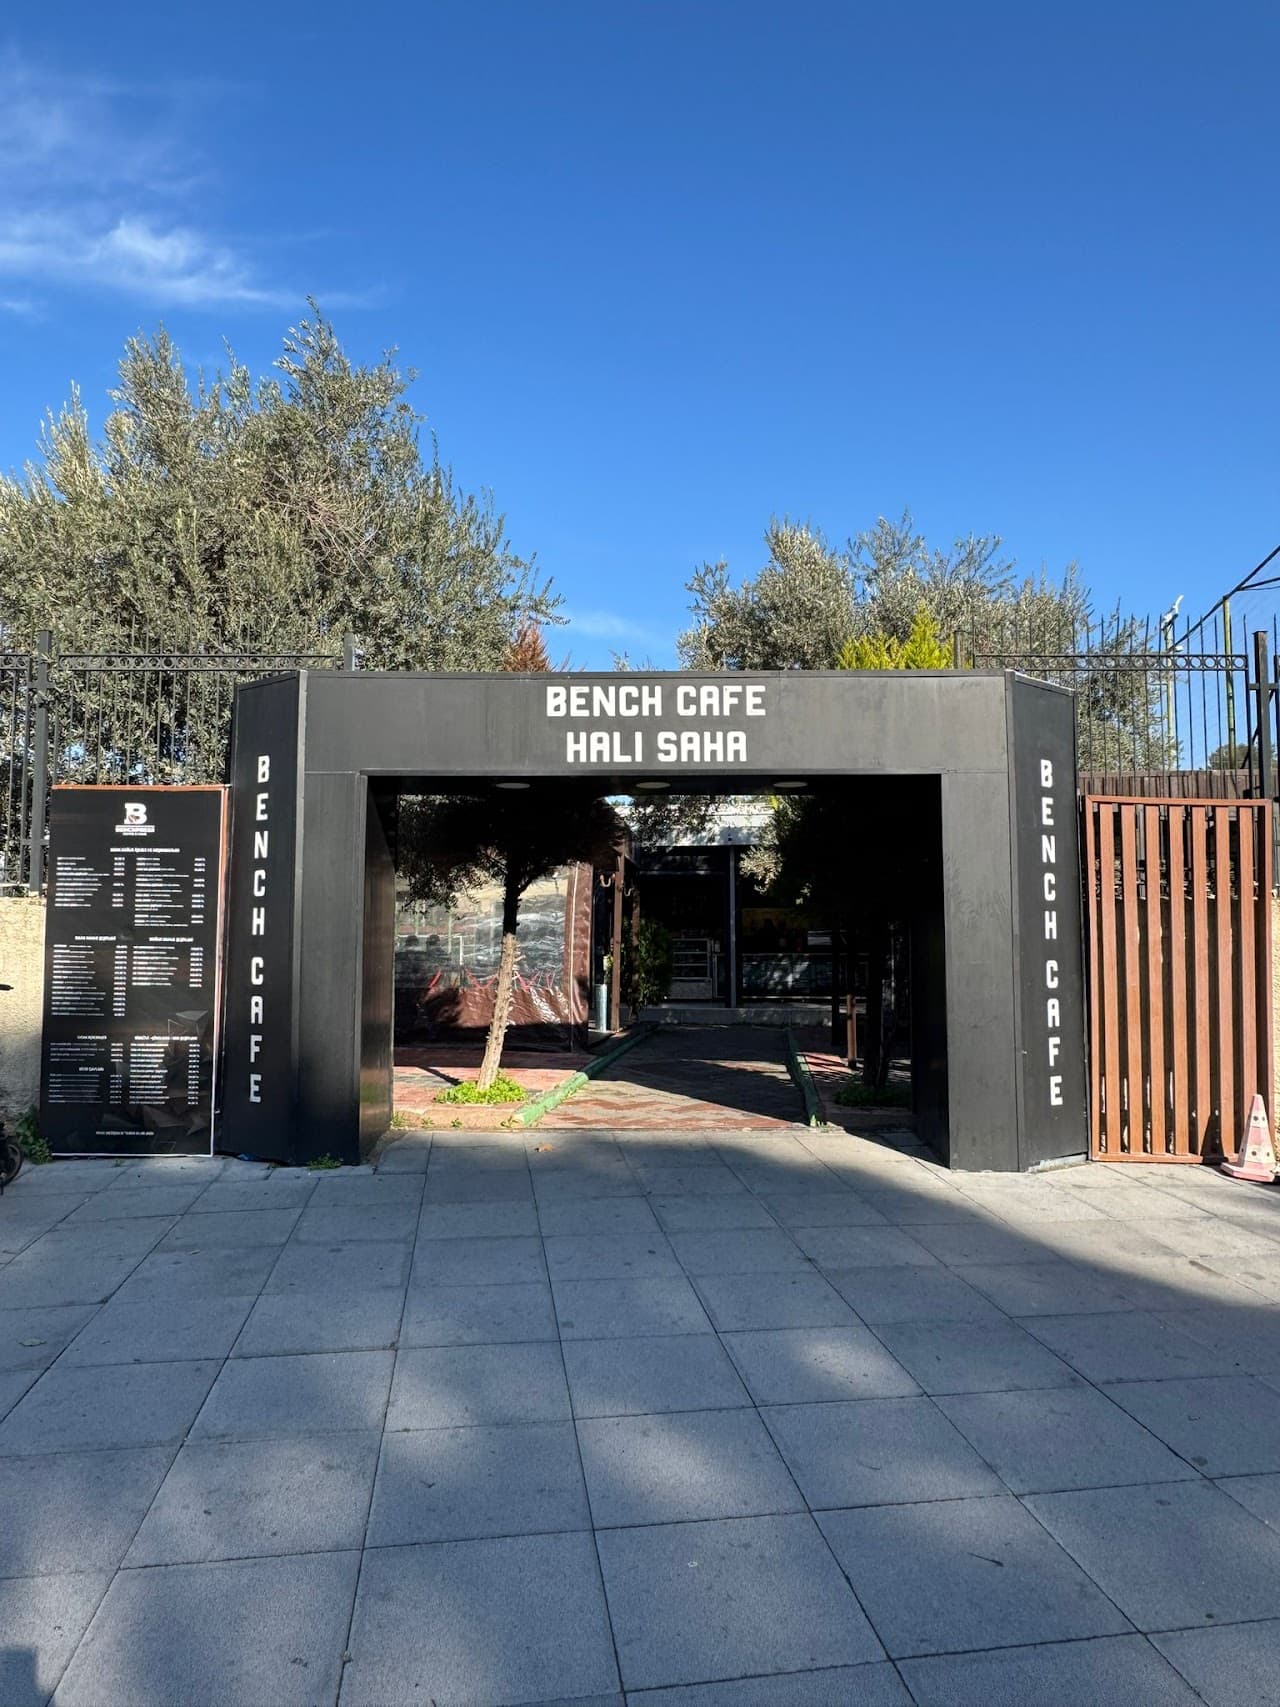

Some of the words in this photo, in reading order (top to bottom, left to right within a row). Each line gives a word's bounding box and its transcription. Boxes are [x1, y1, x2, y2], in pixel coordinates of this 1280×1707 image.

[546, 685, 662, 717] BENCH
[676, 685, 766, 717] CAFE
[566, 731, 643, 763] HALI
[657, 731, 747, 762] SAHA
[124, 802, 148, 825] B
[252, 755, 270, 936] BENCH
[1040, 759, 1057, 940] BENCH
[250, 956, 264, 1104] CAFE
[1046, 959, 1064, 1106] CAFE
